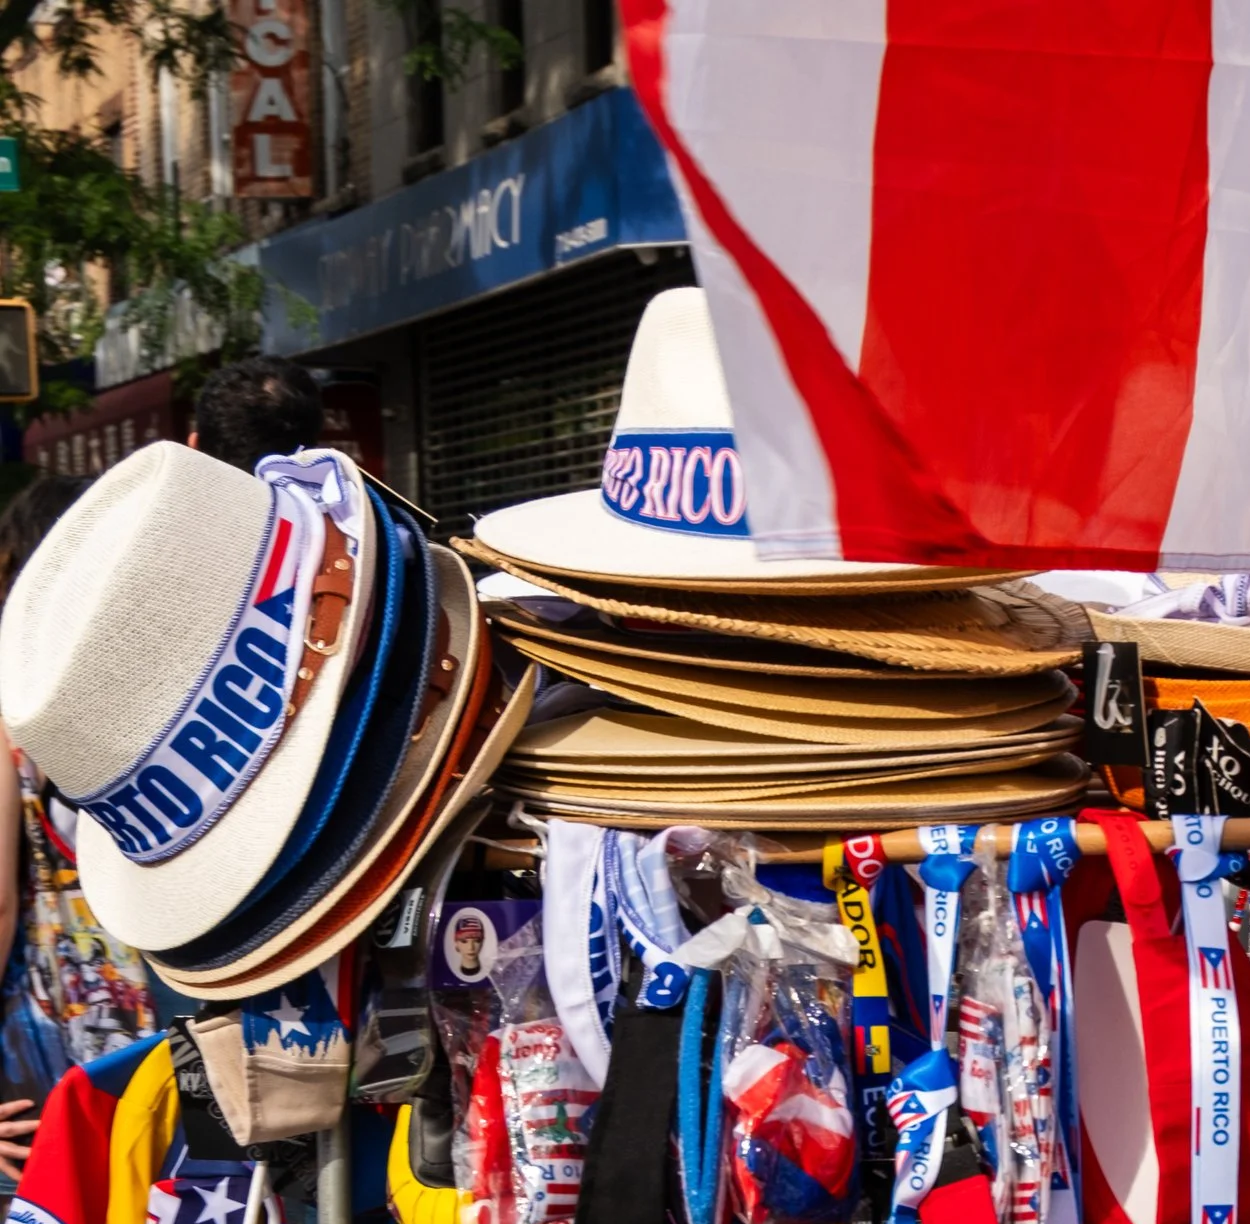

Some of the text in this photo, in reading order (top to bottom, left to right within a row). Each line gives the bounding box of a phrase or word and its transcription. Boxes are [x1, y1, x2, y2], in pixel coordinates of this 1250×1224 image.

[245, 0, 297, 178] CAL
[639, 446, 748, 526] RICO
[169, 627, 287, 793] RICO
[862, 1086, 888, 1158] ECU
[1211, 997, 1230, 1146] PUERTO RICO
[910, 1141, 931, 1191] RICO
